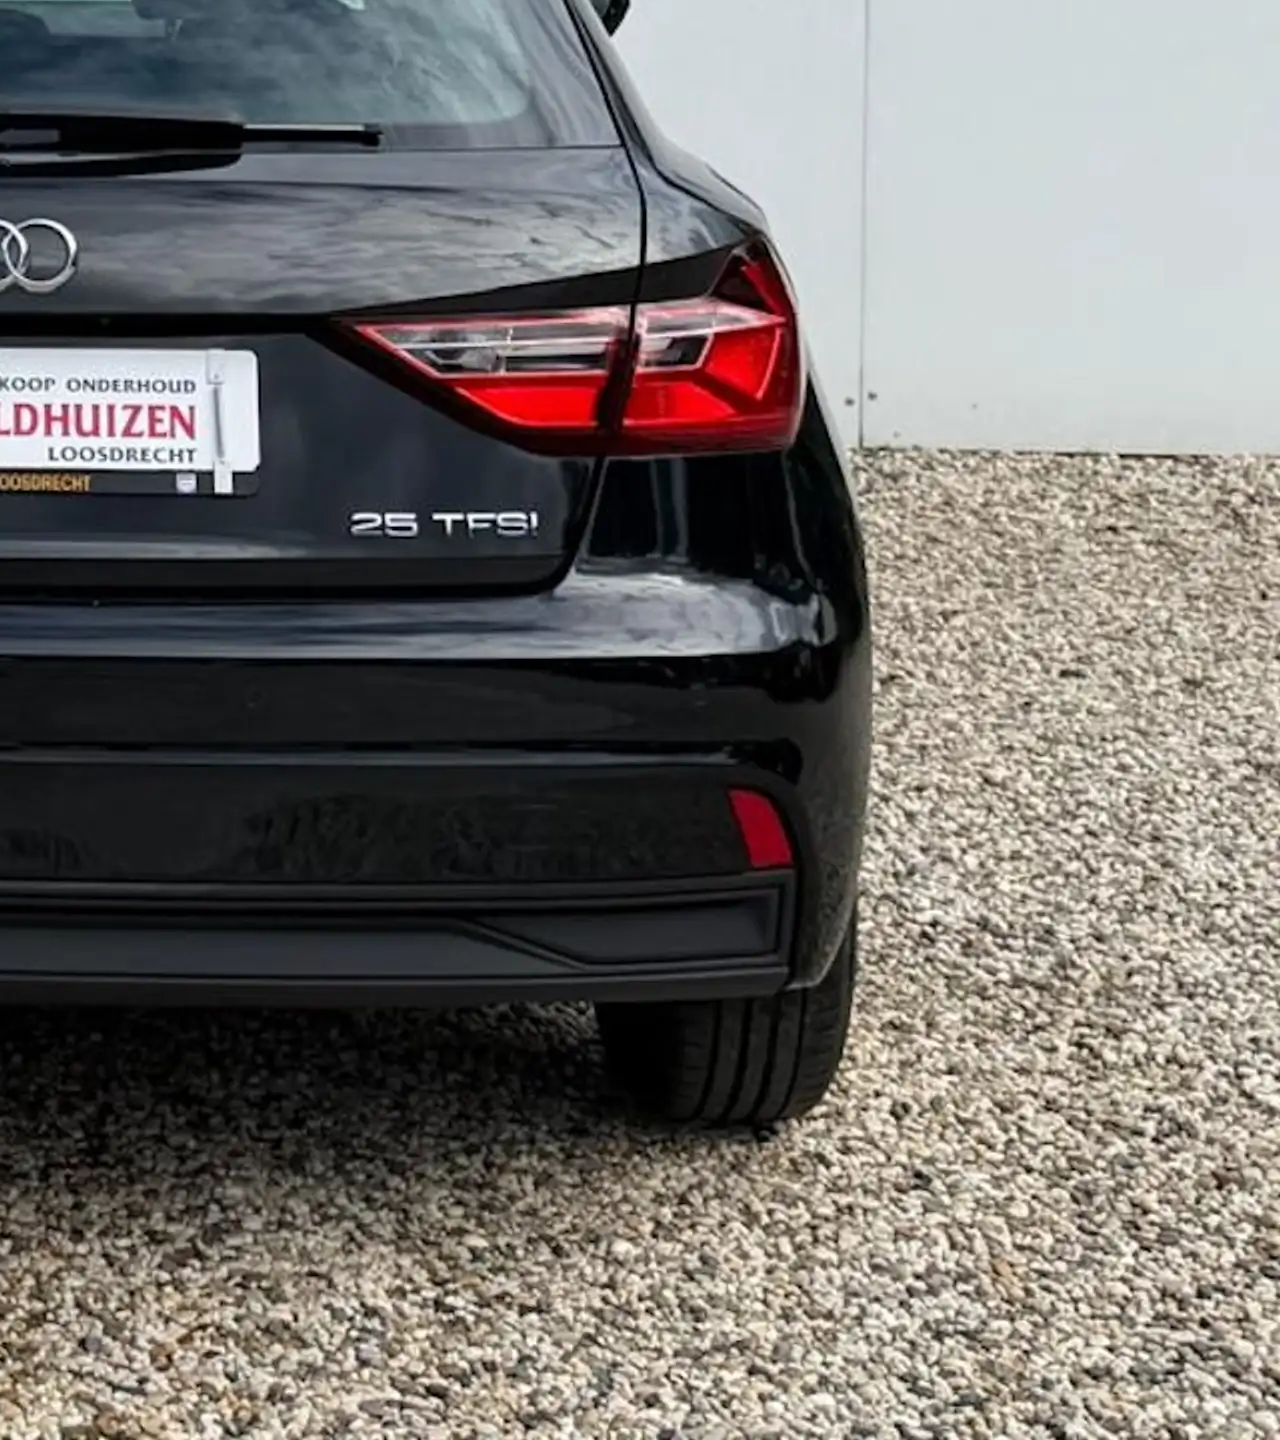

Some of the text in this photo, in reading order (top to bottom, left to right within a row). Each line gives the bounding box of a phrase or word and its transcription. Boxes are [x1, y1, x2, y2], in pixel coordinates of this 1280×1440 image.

[66, 377, 197, 394] ONDERHOUD
[48, 446, 197, 464] LOOSDRECHT
[350, 511, 538, 538] 25 TFSI
